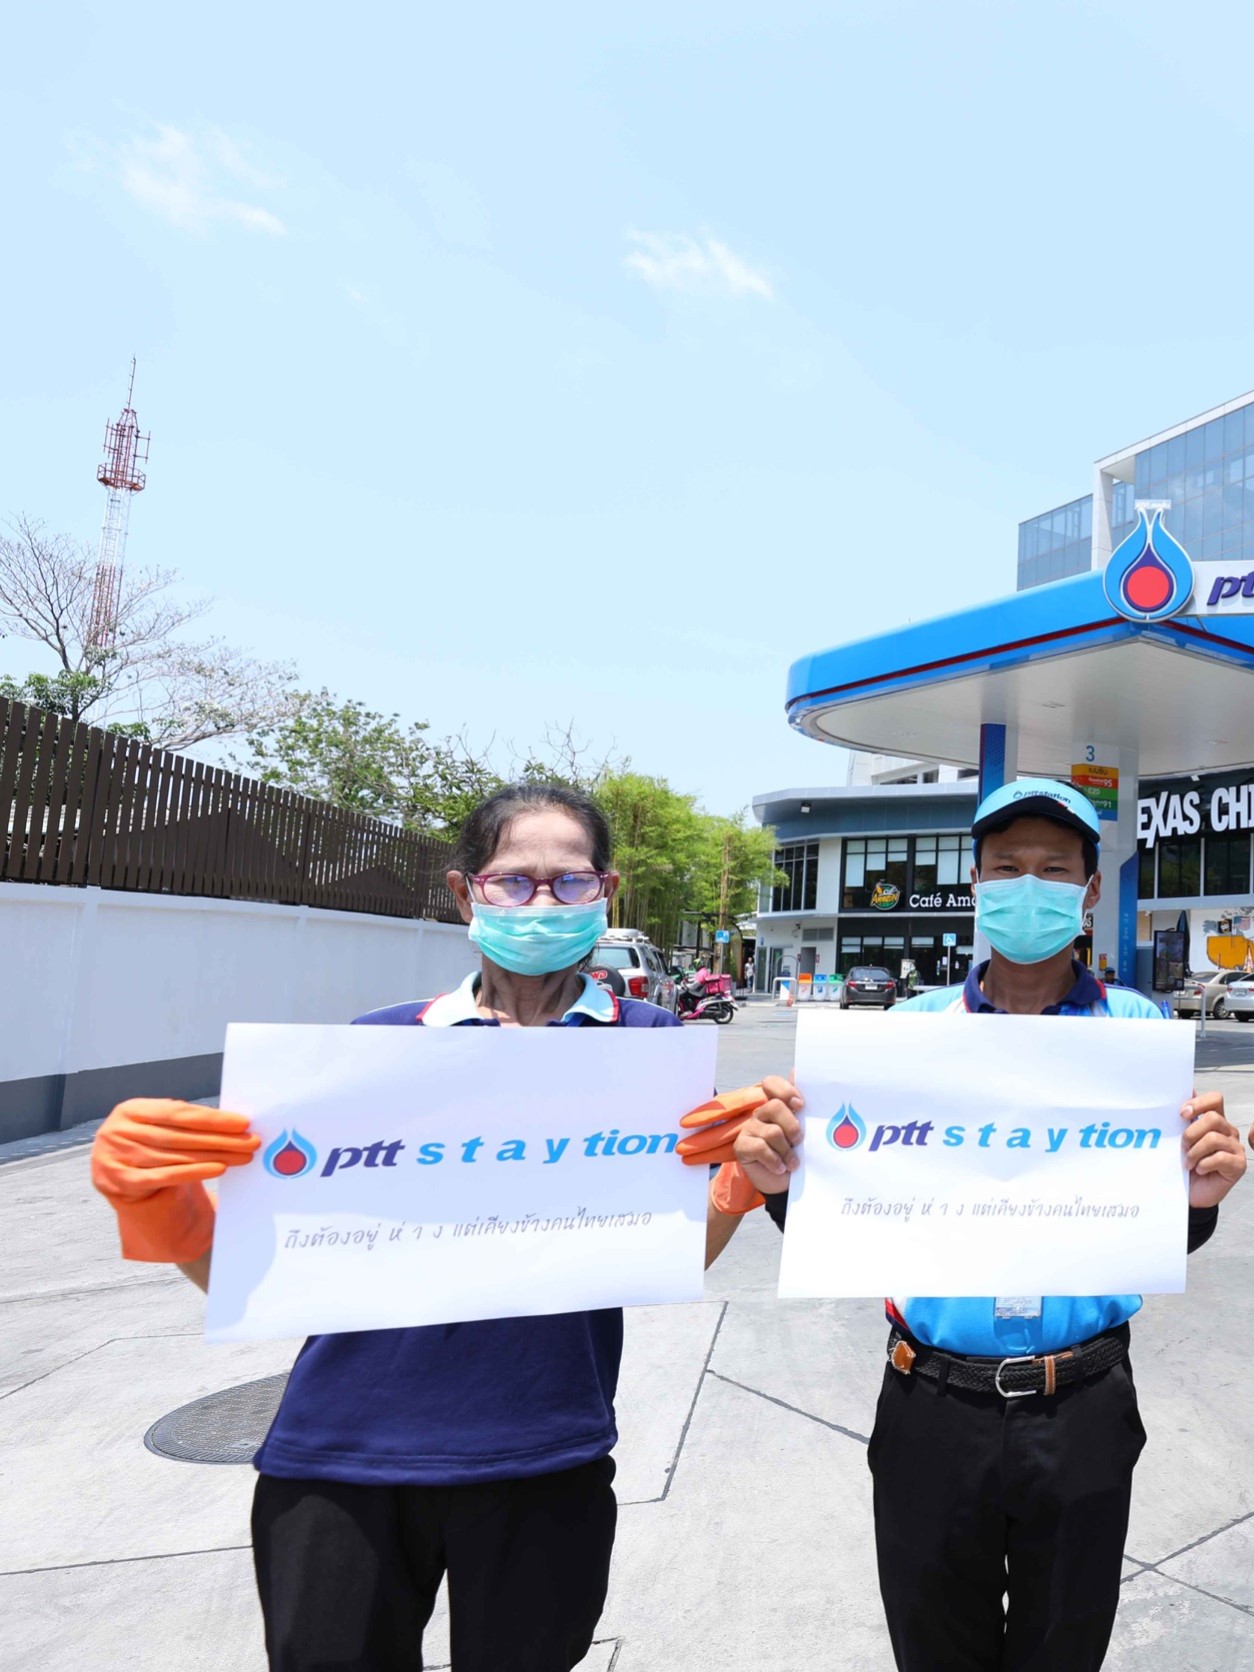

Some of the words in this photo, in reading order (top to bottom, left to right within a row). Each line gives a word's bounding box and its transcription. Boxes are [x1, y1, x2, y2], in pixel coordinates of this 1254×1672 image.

[1086, 745, 1095, 762] 3
[1088, 787, 1100, 795] E20
[1103, 779, 1113, 787] 95
[1103, 800, 1112, 808] 91
[909, 892, 943, 908] Café
[868, 1120, 935, 1152] ptt
[320, 1138, 405, 1177] ptt
